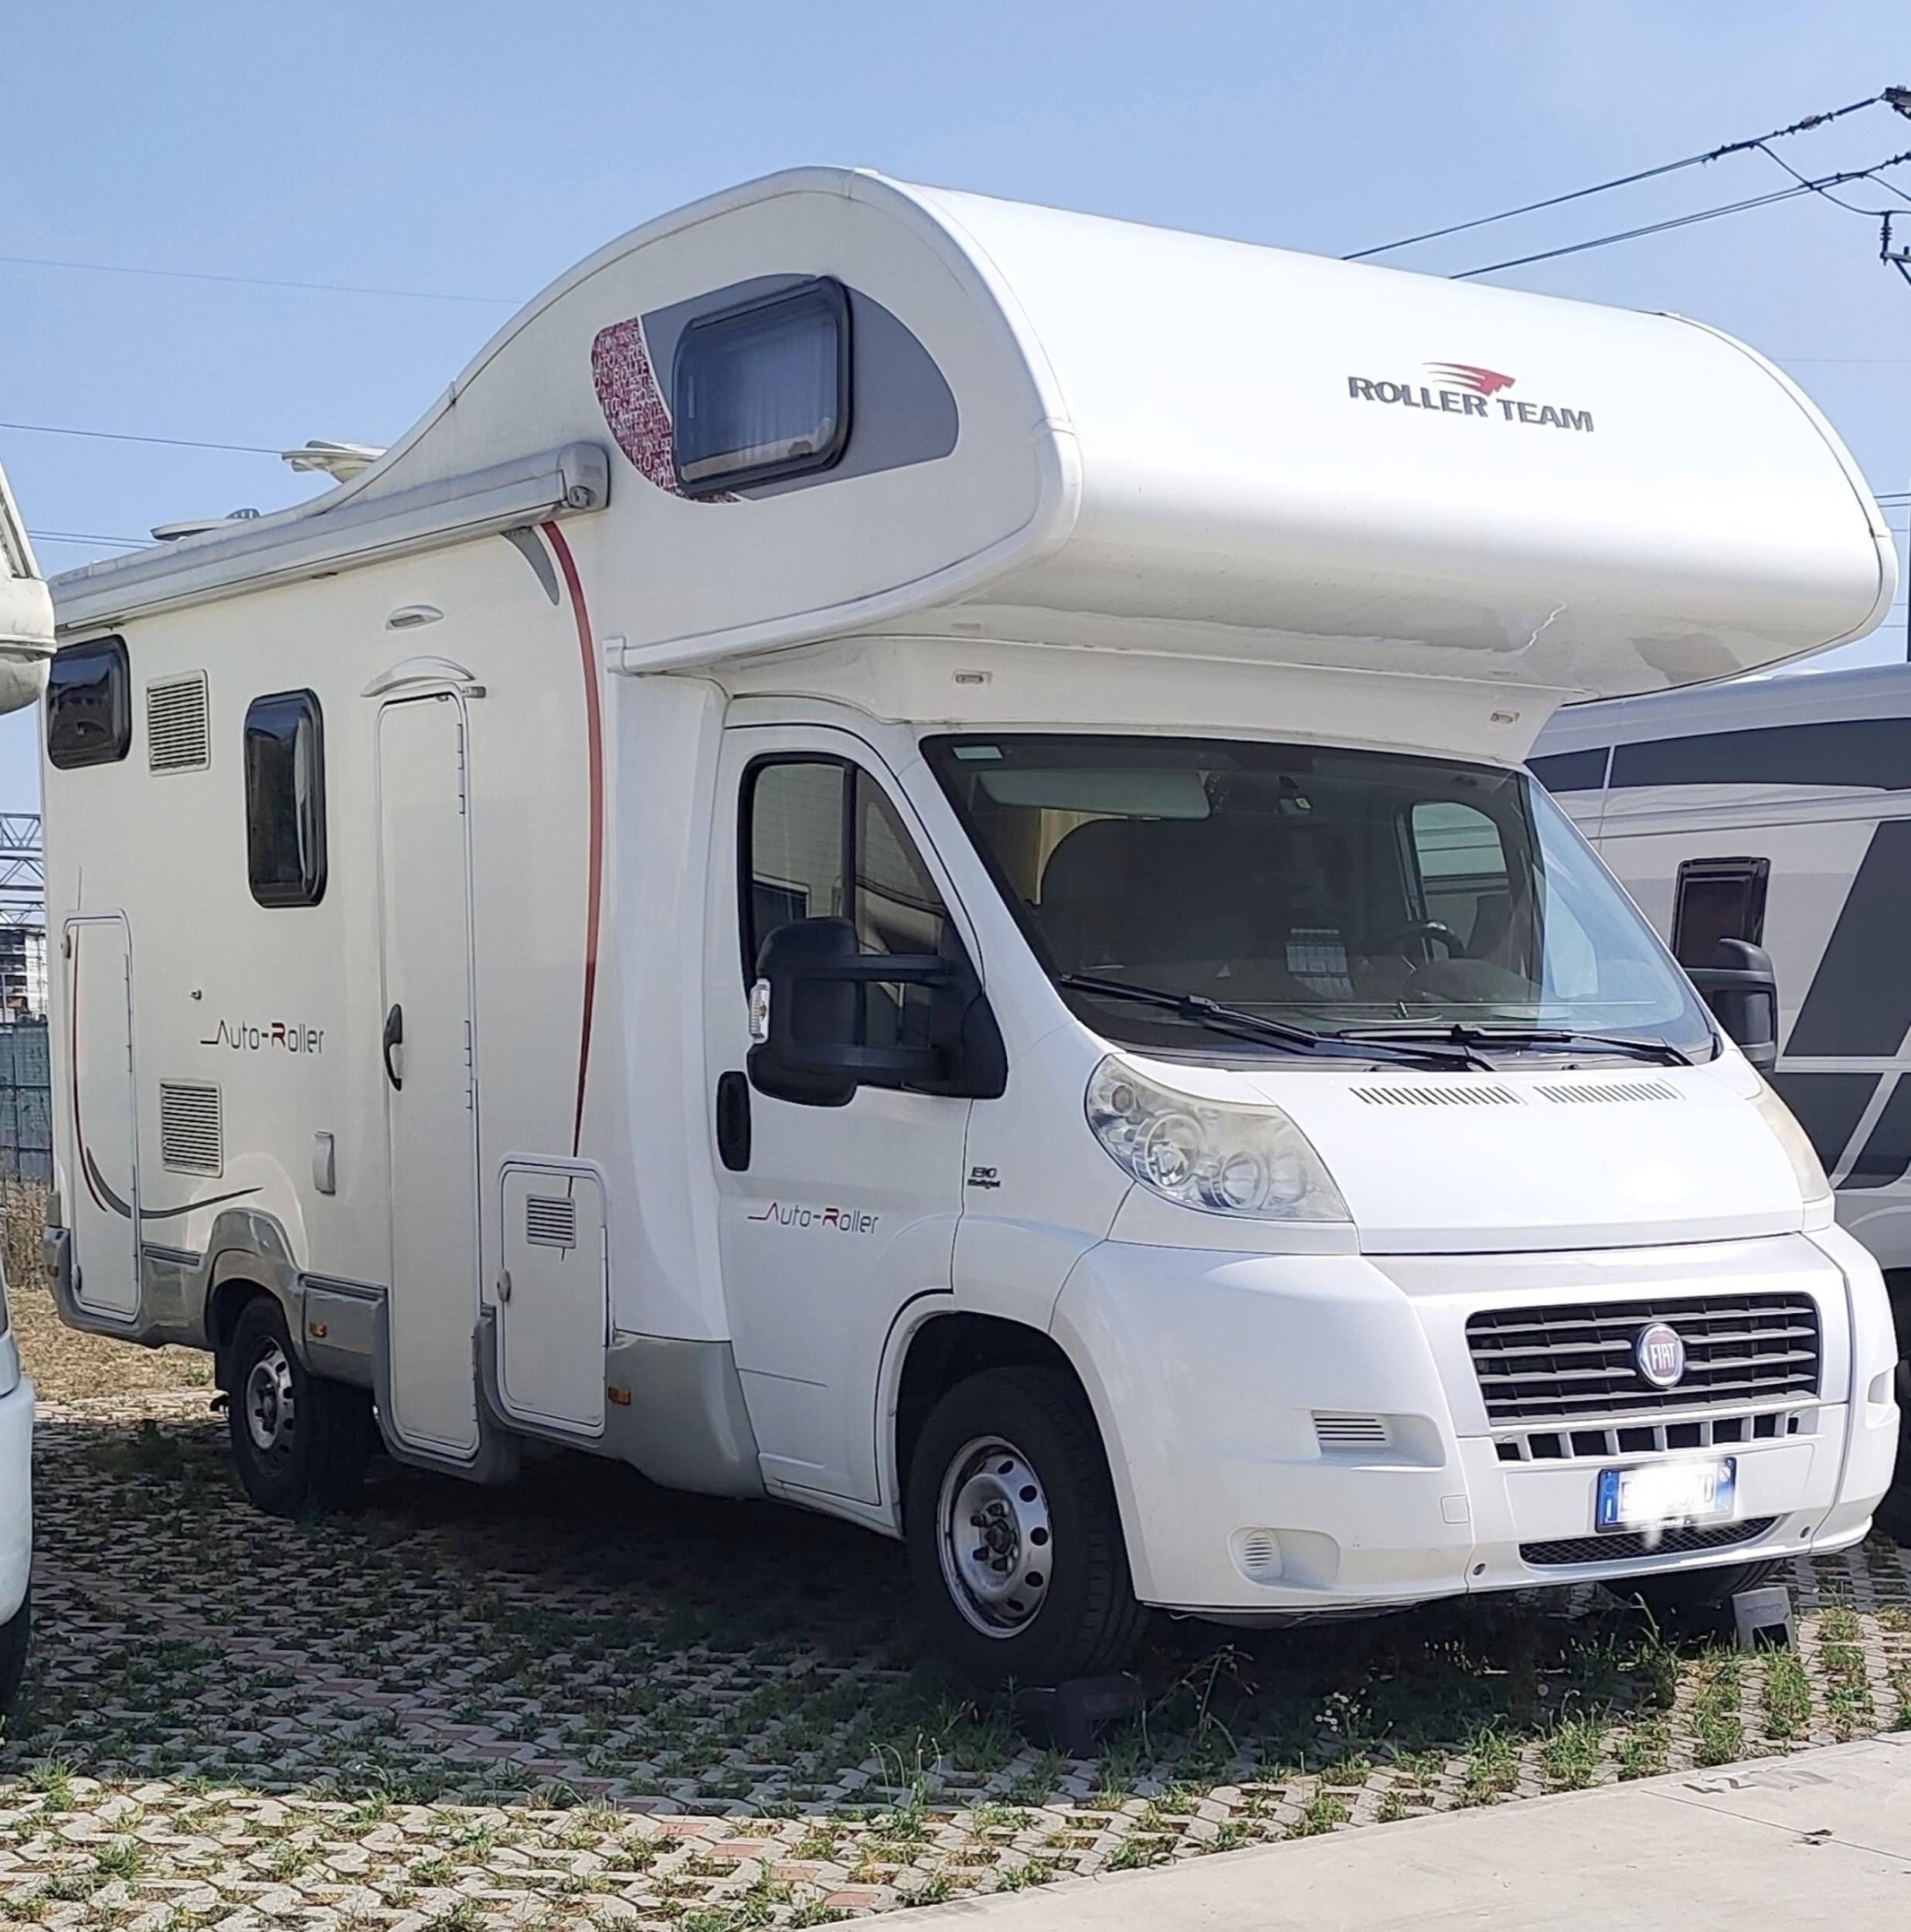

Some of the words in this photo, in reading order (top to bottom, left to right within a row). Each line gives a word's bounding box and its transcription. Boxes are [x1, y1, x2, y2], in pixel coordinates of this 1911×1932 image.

[1347, 376, 1488, 418] ROLLER
[1496, 397, 1594, 433] TEAM
[200, 1019, 324, 1054] Auto-Roller
[747, 1202, 879, 1234] Auto-Roller
[1649, 1342, 1675, 1370] FIAT
